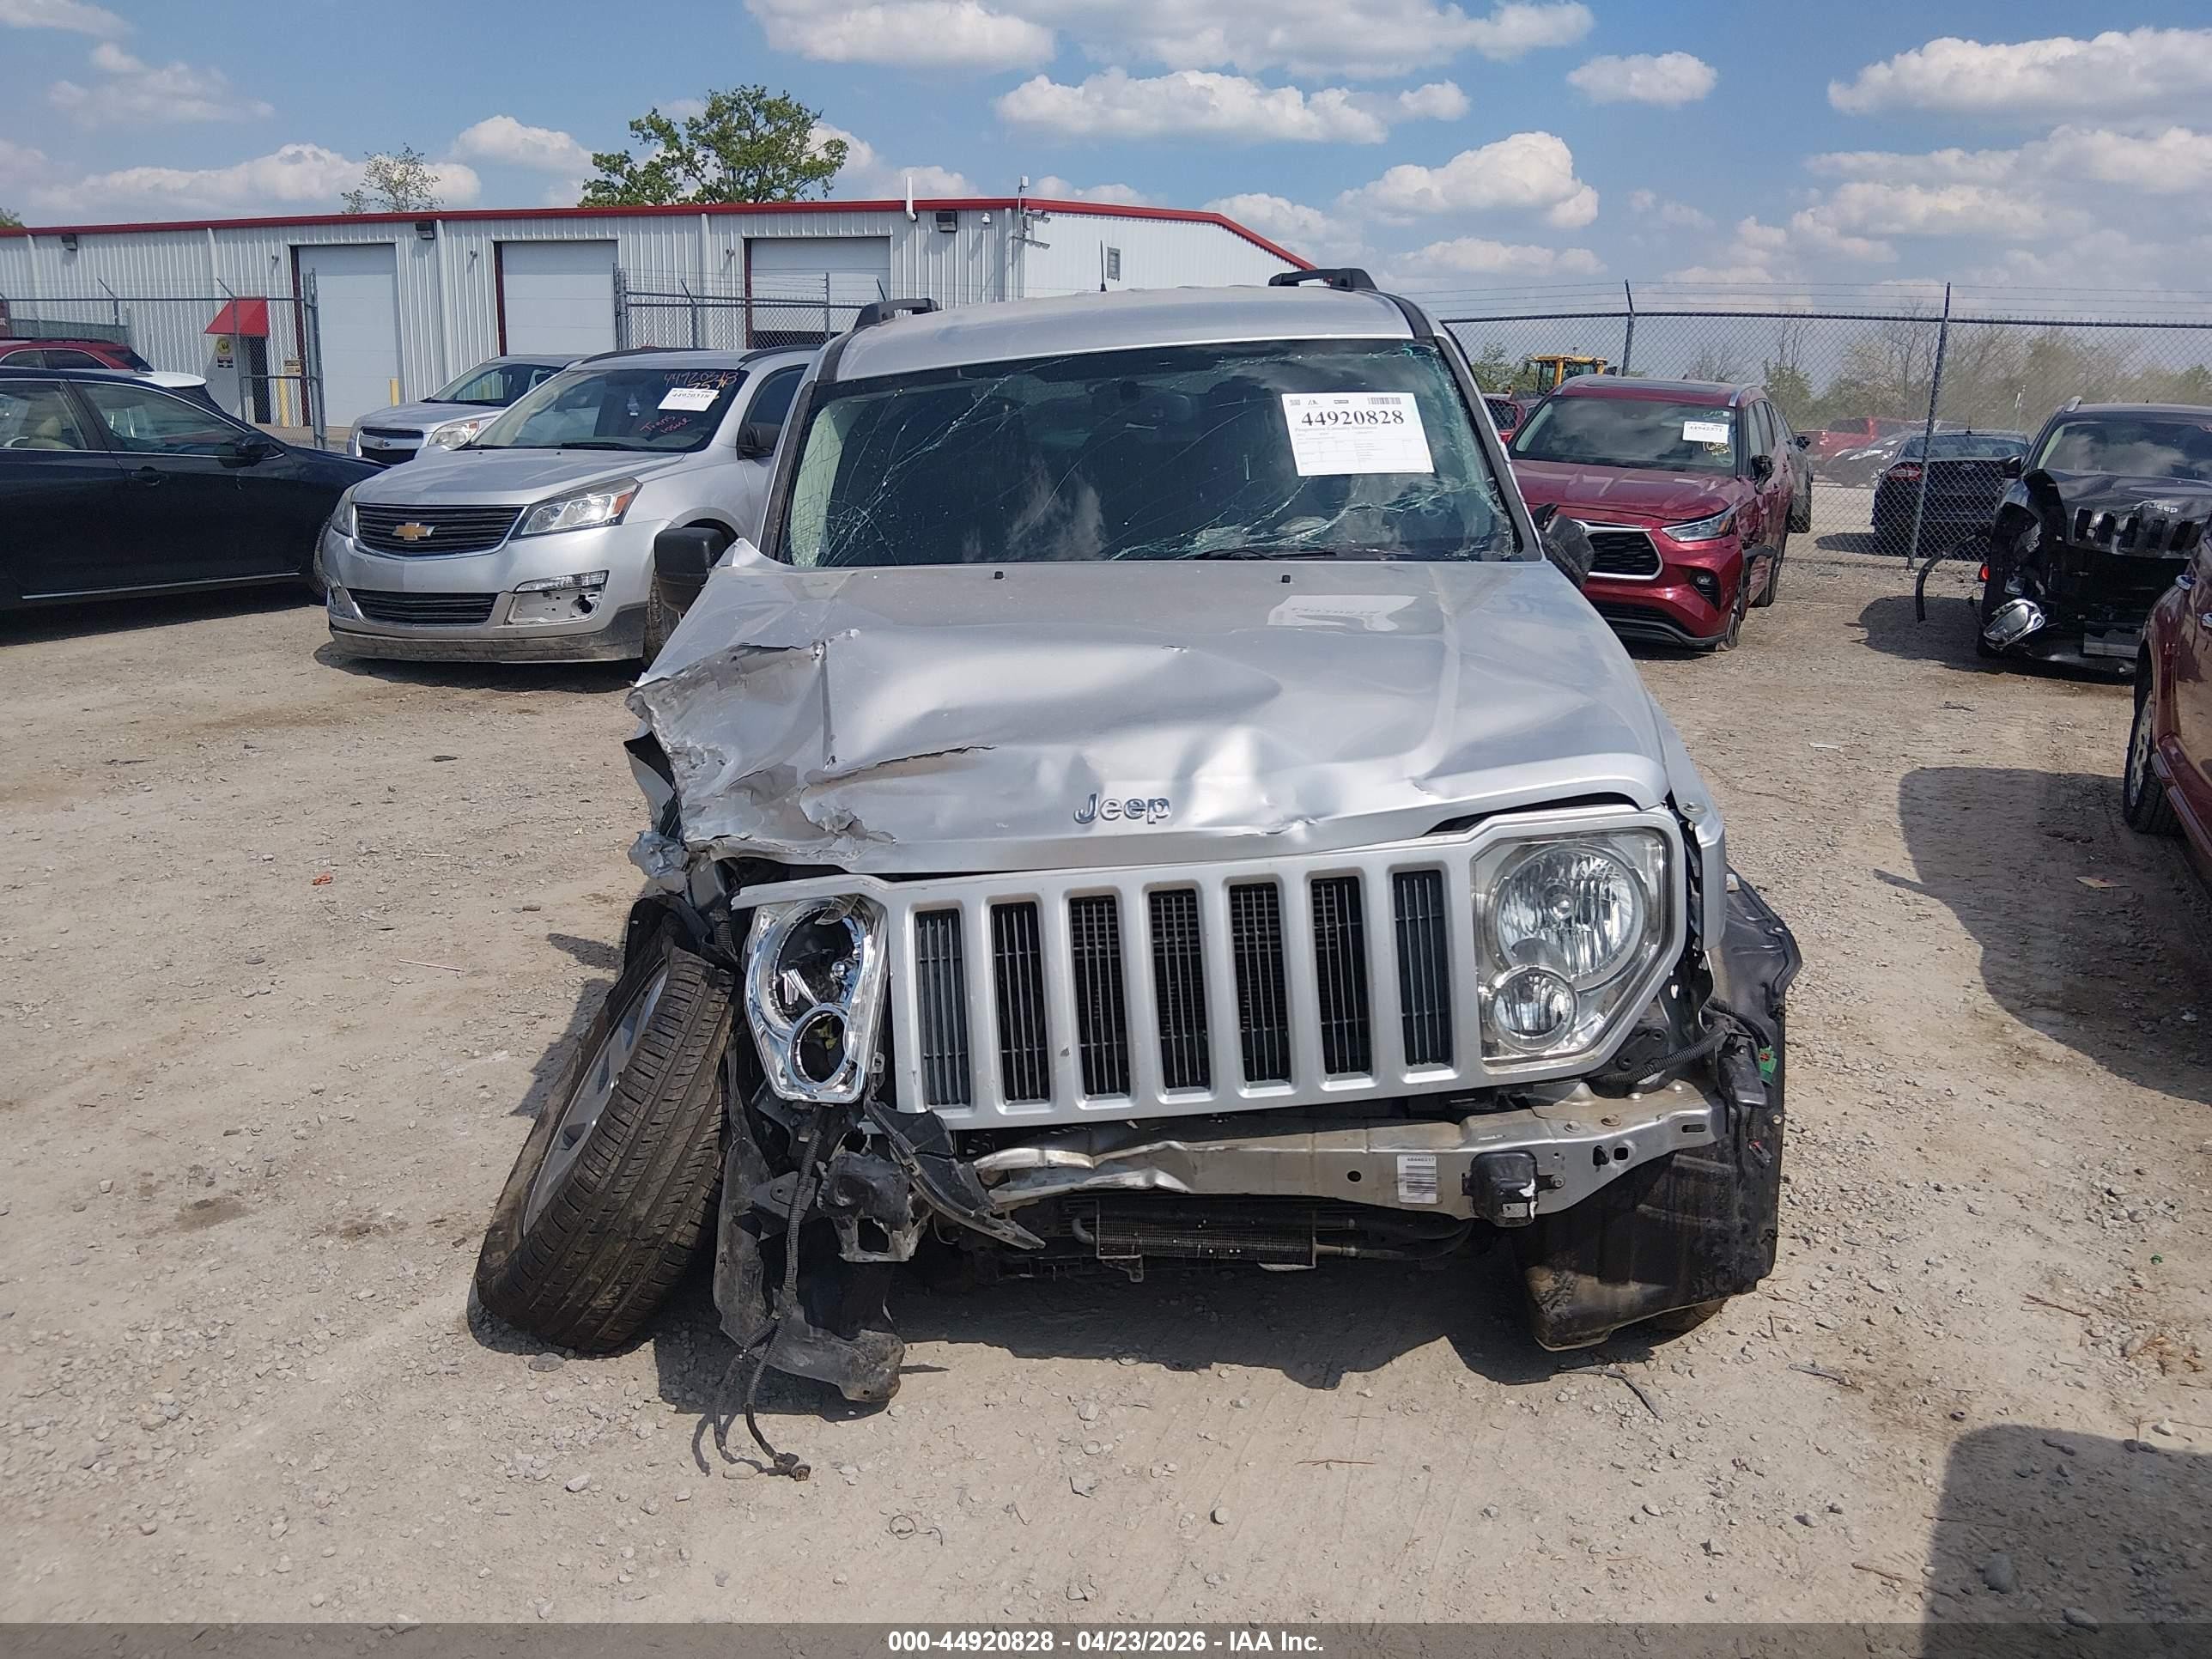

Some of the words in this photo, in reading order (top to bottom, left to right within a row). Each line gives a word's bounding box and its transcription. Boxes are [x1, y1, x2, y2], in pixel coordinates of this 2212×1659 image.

[1301, 410, 1405, 426] 44920828
[2149, 501, 2178, 514] Jeep
[1073, 792, 1171, 824] Jeep
